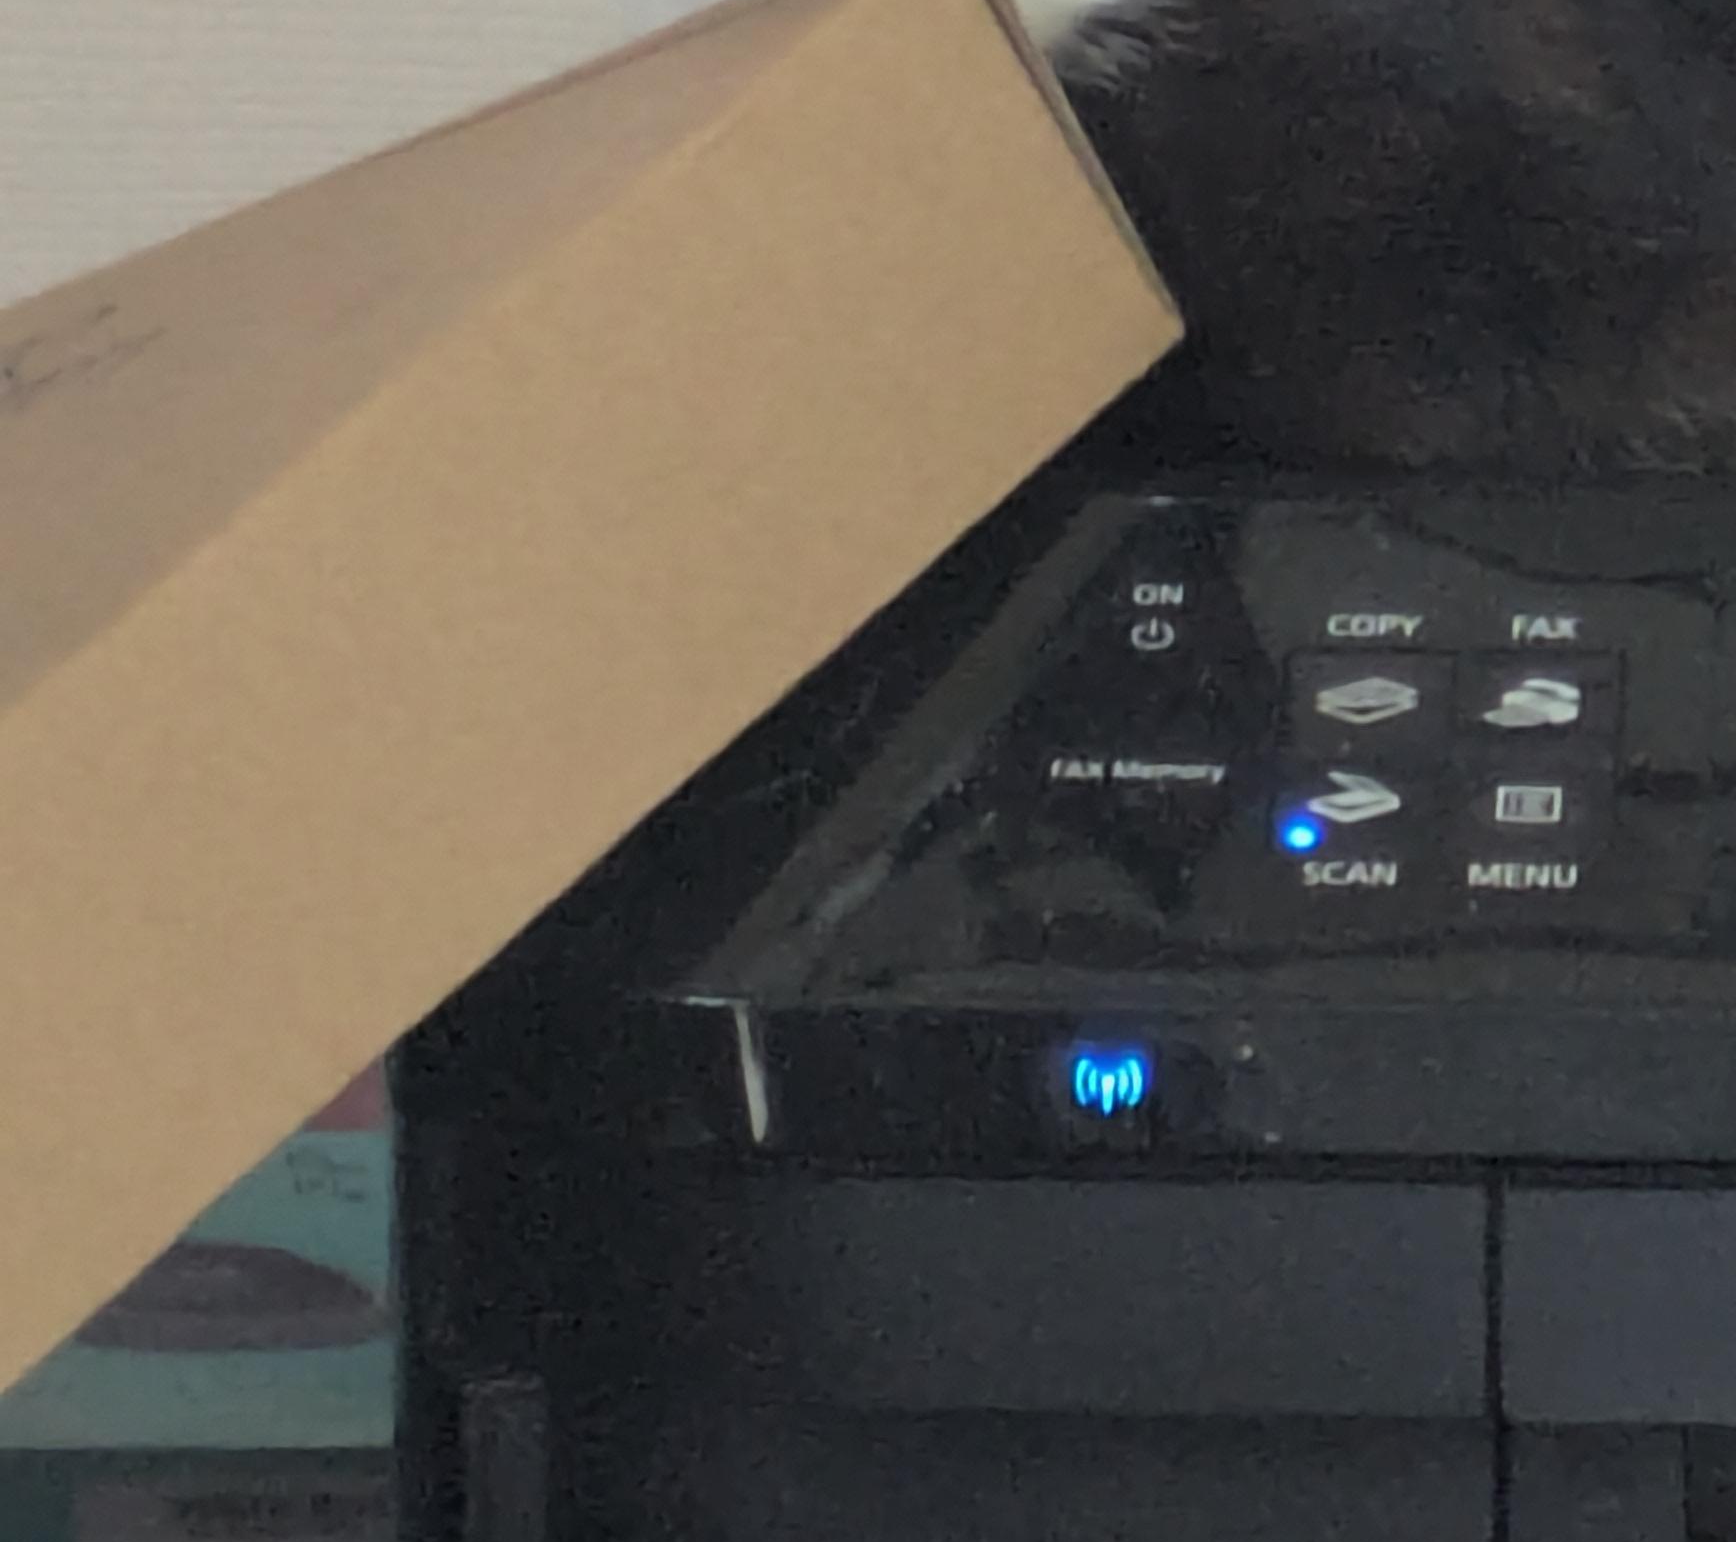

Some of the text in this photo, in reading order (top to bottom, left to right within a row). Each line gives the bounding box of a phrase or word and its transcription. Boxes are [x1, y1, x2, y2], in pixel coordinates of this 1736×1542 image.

[1133, 583, 1183, 605] ON
[1327, 614, 1423, 638] COPY
[1511, 615, 1578, 640] FAX
[1302, 862, 1396, 887] SCAN
[1466, 864, 1578, 889] MENU
